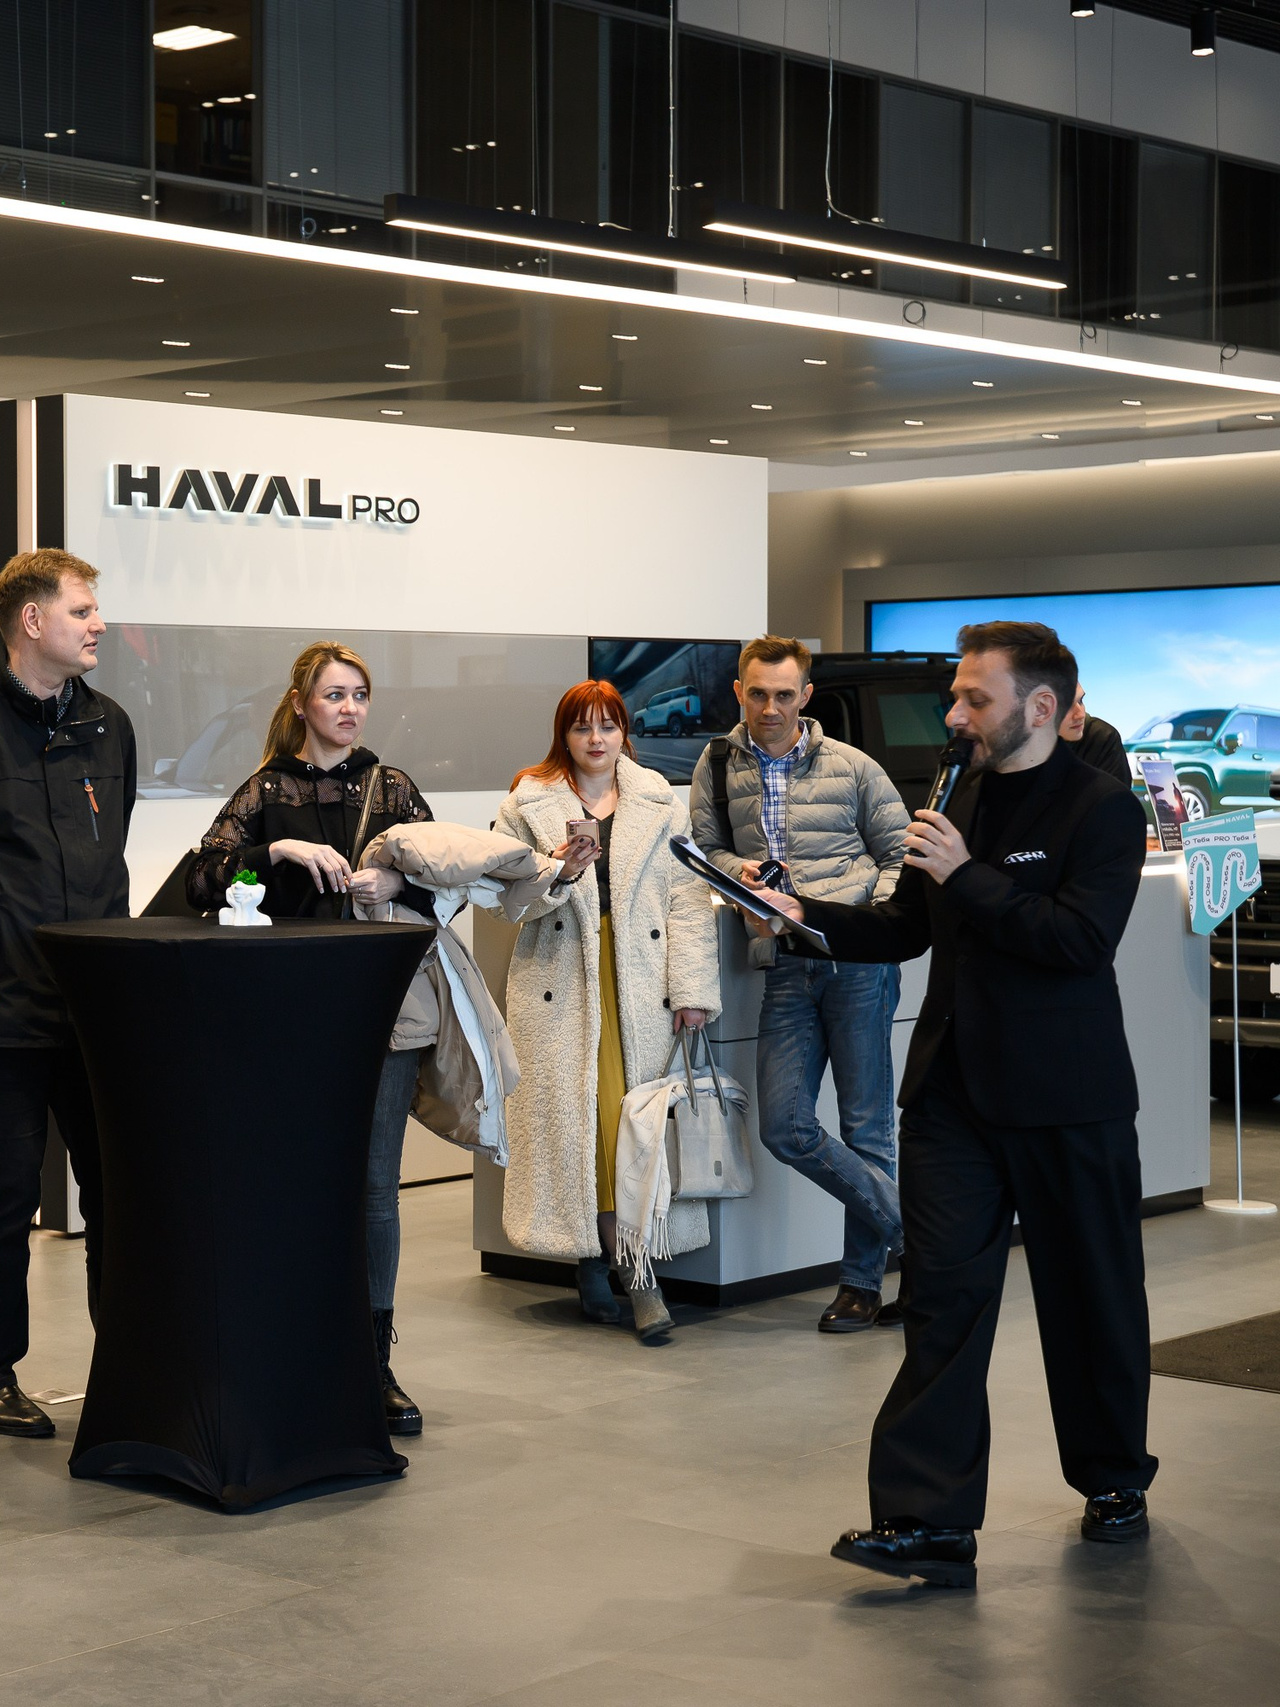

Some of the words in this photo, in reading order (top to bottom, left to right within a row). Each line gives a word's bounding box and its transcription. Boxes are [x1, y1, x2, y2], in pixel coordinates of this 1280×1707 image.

[113, 463, 342, 519] HAVAL
[348, 494, 420, 524] PRO
[1225, 814, 1251, 823] HAVAL
